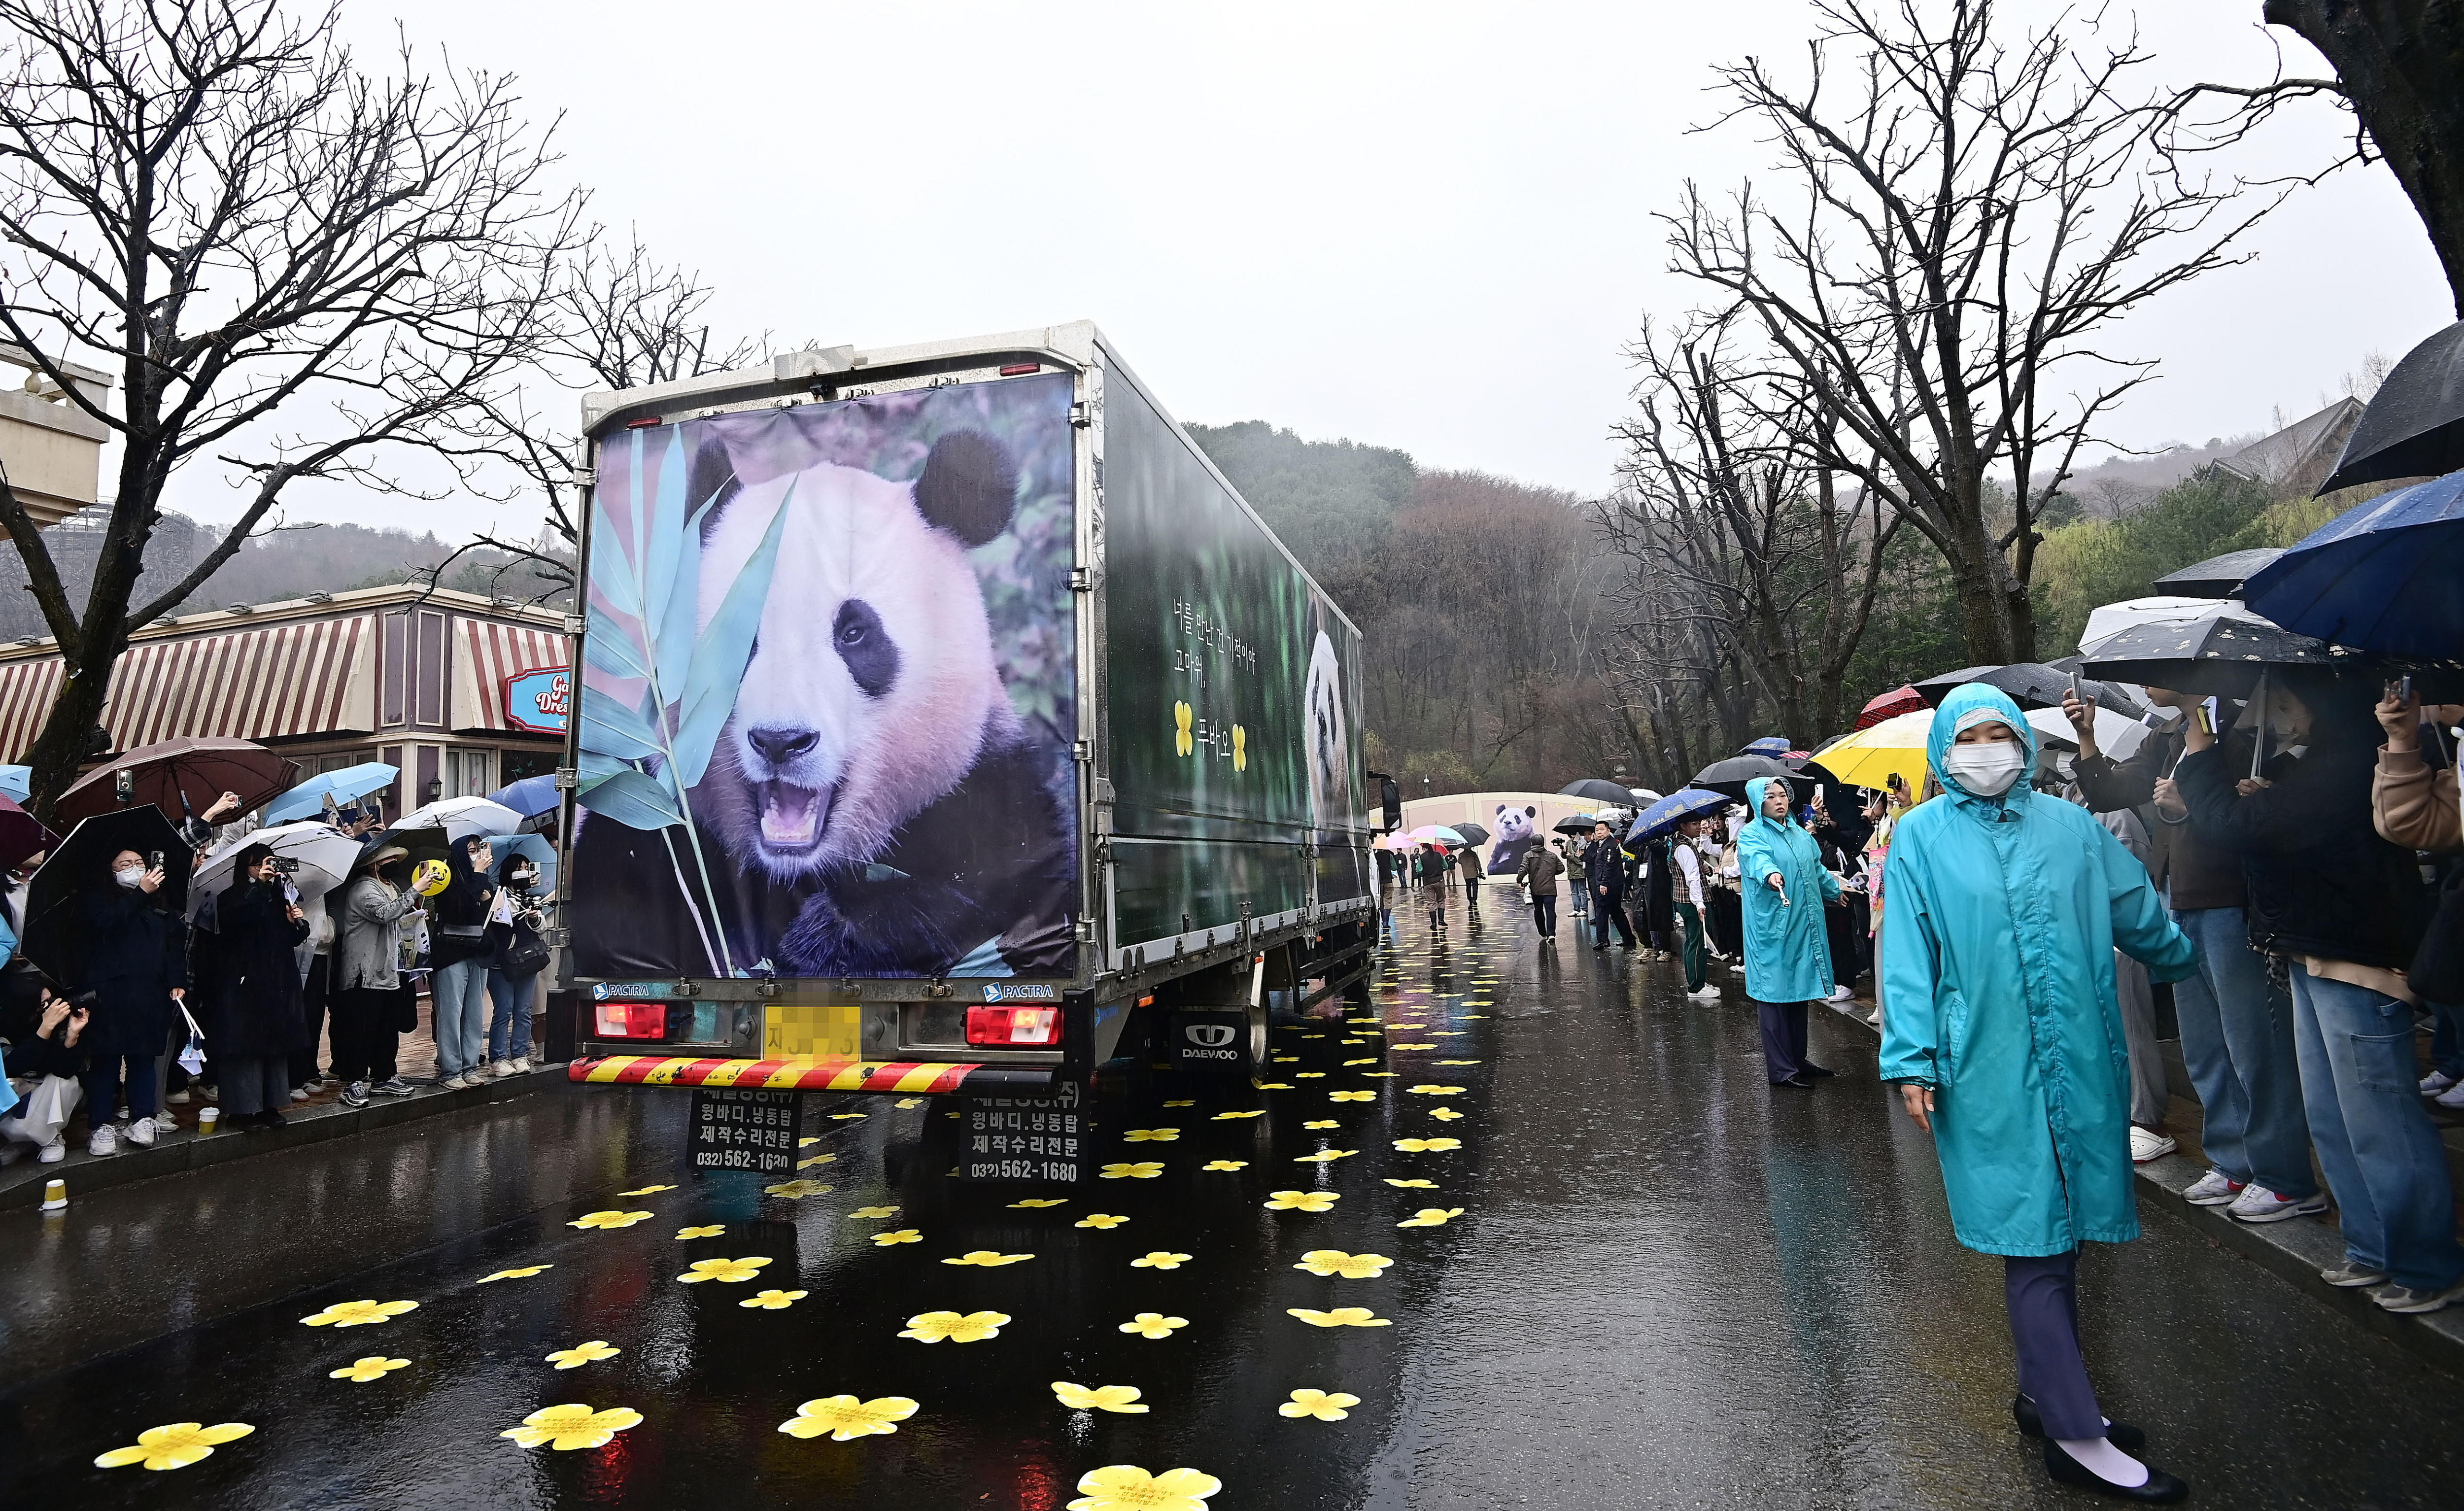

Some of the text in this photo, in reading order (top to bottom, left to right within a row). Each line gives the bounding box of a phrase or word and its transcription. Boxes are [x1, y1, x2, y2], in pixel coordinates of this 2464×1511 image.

[1173, 596, 1256, 675] 너를 만난 건 기적이야
[1174, 649, 1205, 688] 고마워,
[1197, 719, 1231, 762] 푸바오
[609, 984, 649, 996] PACTRA
[1003, 984, 1054, 998] PACTRA
[1182, 1049, 1238, 1060] DAEWOO
[700, 1126, 790, 1149] 제작수리전문
[972, 1135, 1078, 1158] 제작수리전문
